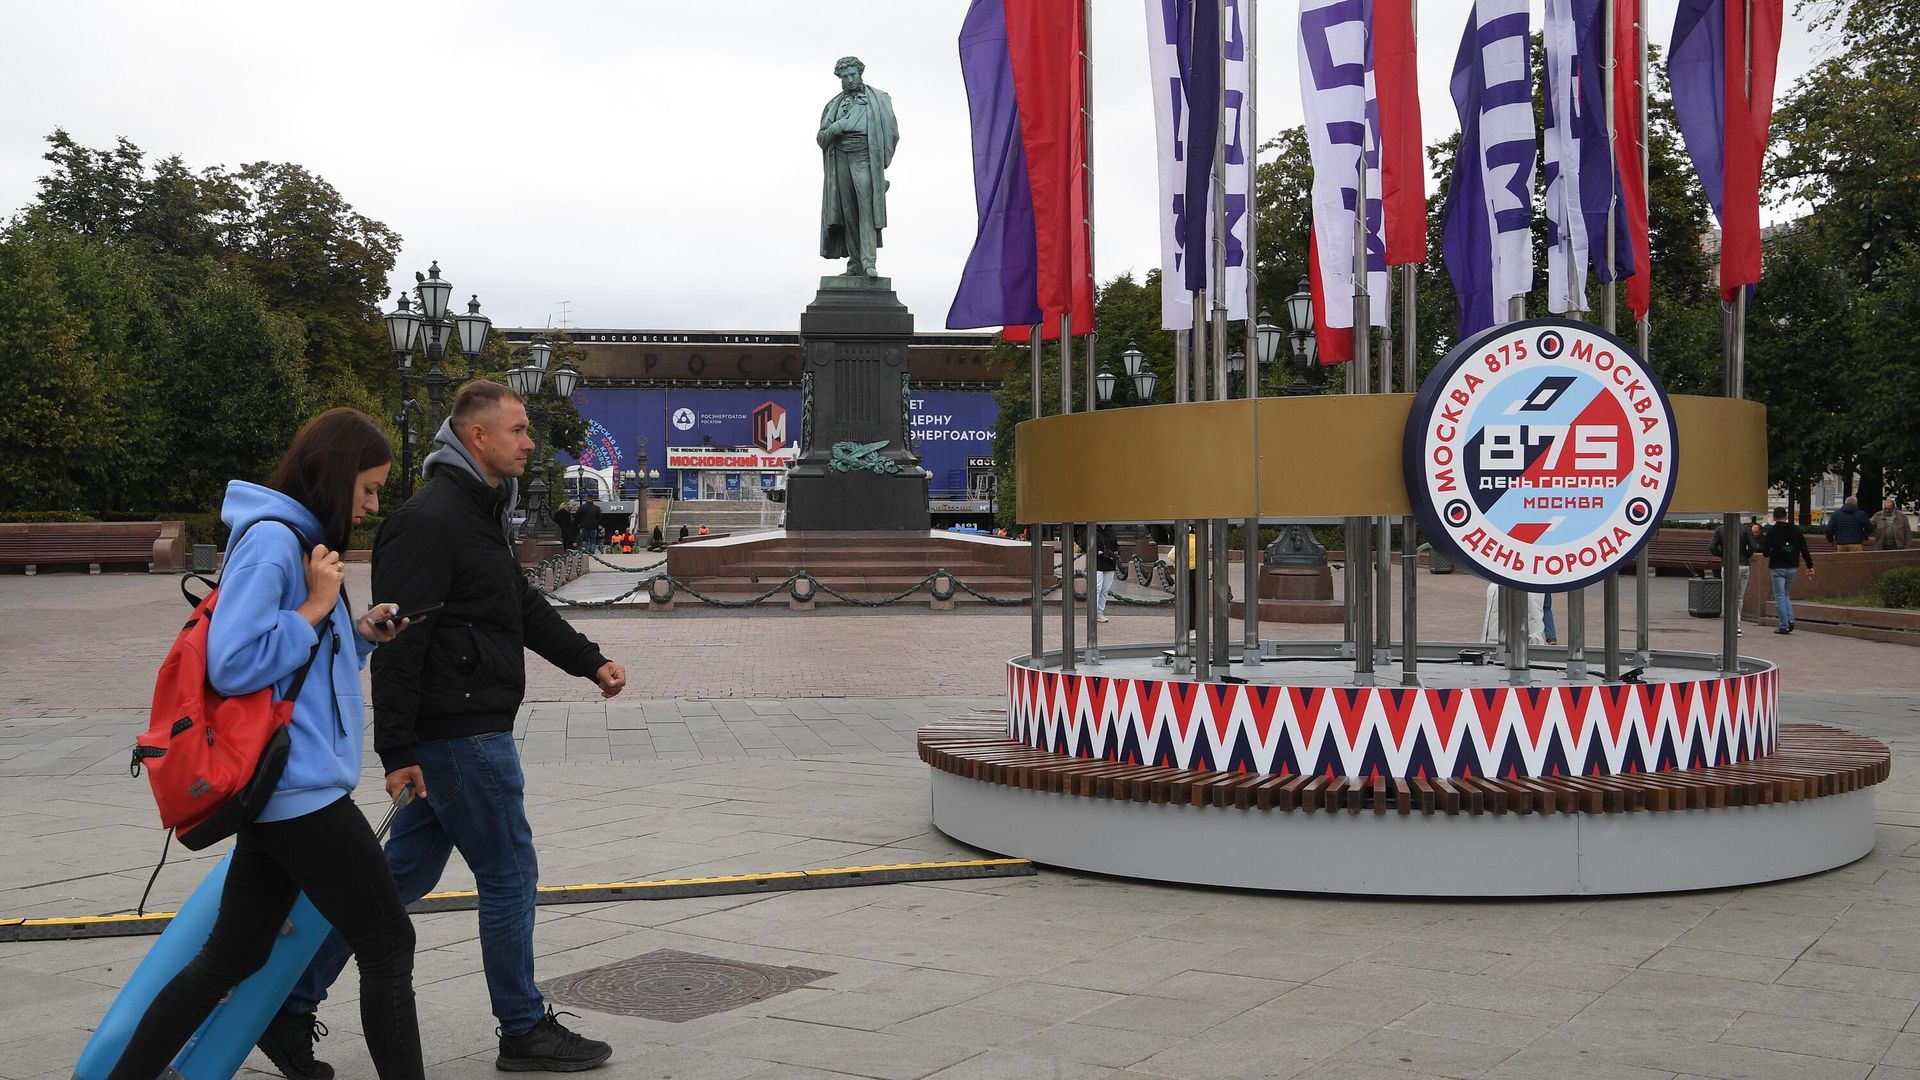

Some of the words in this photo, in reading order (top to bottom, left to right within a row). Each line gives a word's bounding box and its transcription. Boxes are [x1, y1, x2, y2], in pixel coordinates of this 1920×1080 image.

[1433, 372, 1485, 493] МОСКВА
[1484, 339, 1528, 373] 875
[1569, 338, 1659, 435] МОСКВА
[1640, 443, 1664, 491] 875
[670, 455, 758, 467] МОСКОВСКИЙ
[1479, 424, 1618, 471] 875
[1479, 476, 1533, 490] ДЕНЬ
[1538, 476, 1617, 489] ГОРОДА
[1523, 496, 1604, 509] МОСКВА
[1461, 526, 1525, 572] ДЕНЬ
[1532, 525, 1632, 575] ГОРОДА
